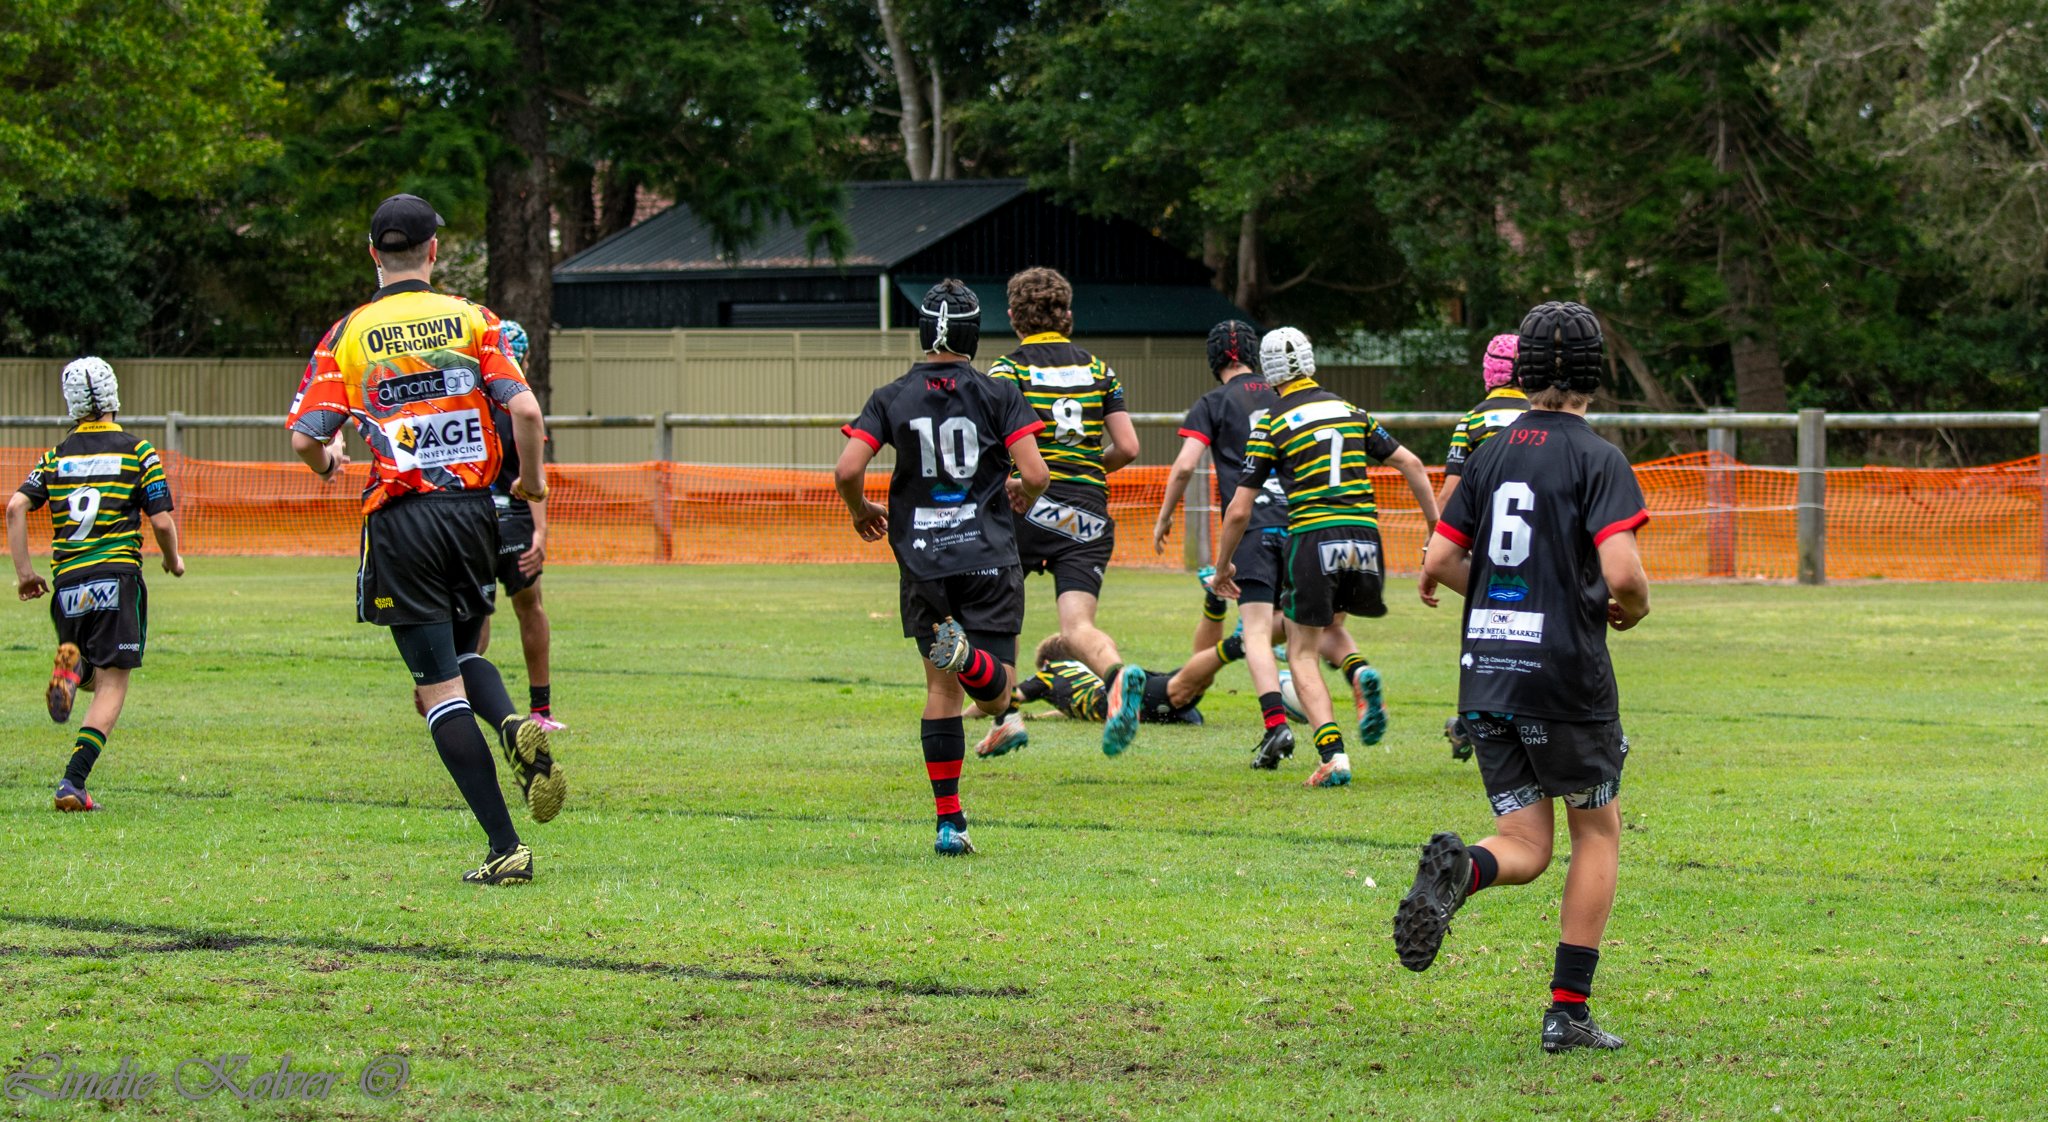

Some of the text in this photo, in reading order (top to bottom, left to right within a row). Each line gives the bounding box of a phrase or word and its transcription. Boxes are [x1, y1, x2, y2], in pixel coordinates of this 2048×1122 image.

[367, 316, 463, 353] OUR TOWN
[385, 334, 448, 356] FENCING
[925, 377, 956, 391] 1973
[1052, 398, 1087, 446] 8
[418, 445, 483, 459] ONVEYANCING
[910, 416, 979, 479] 10
[1509, 429, 1549, 446] 1973
[1313, 428, 1344, 488] 7
[67, 486, 101, 541] 9
[1488, 481, 1535, 567] 6
[1509, 629, 1542, 639] MARKET
[1490, 656, 1517, 667] Country
[1518, 659, 1542, 668] Meats
